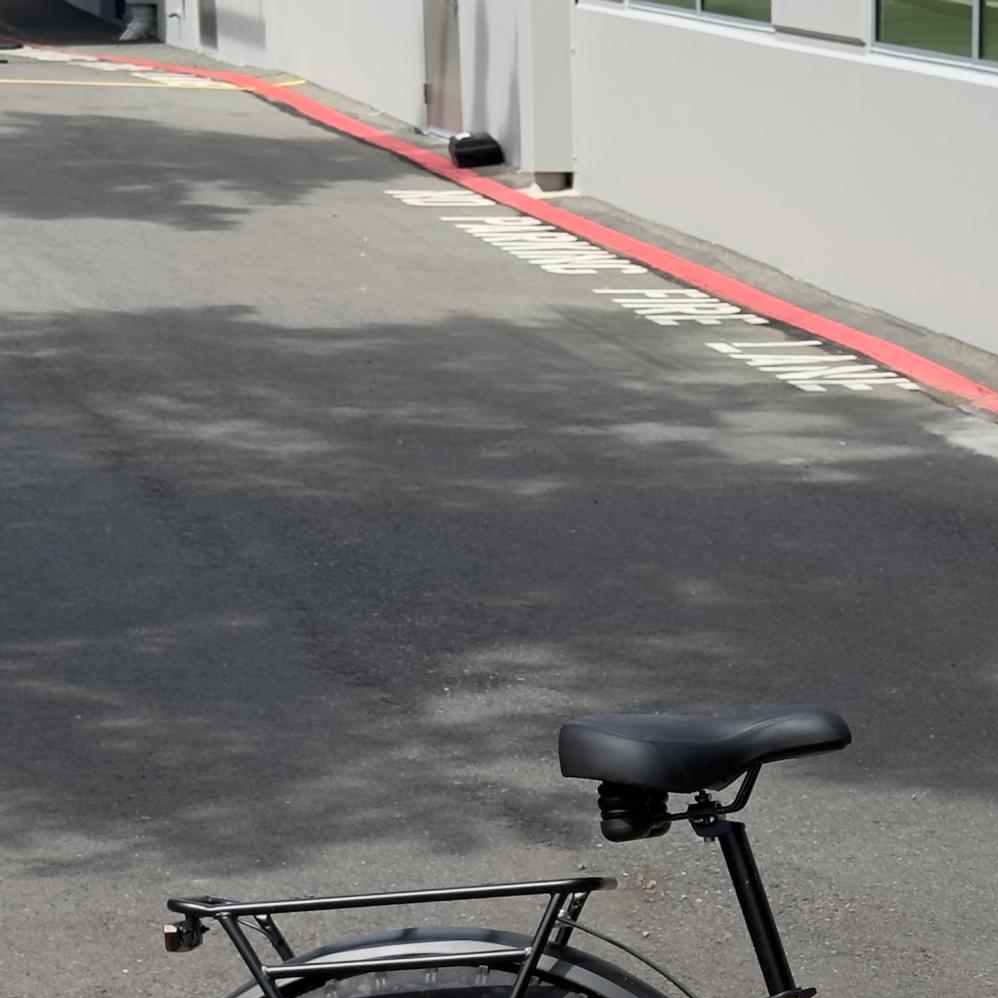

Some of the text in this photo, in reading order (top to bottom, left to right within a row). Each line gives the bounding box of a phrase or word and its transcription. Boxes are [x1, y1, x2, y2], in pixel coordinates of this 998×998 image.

[384, 189, 921, 393] NO PARKING FIRE LANE
